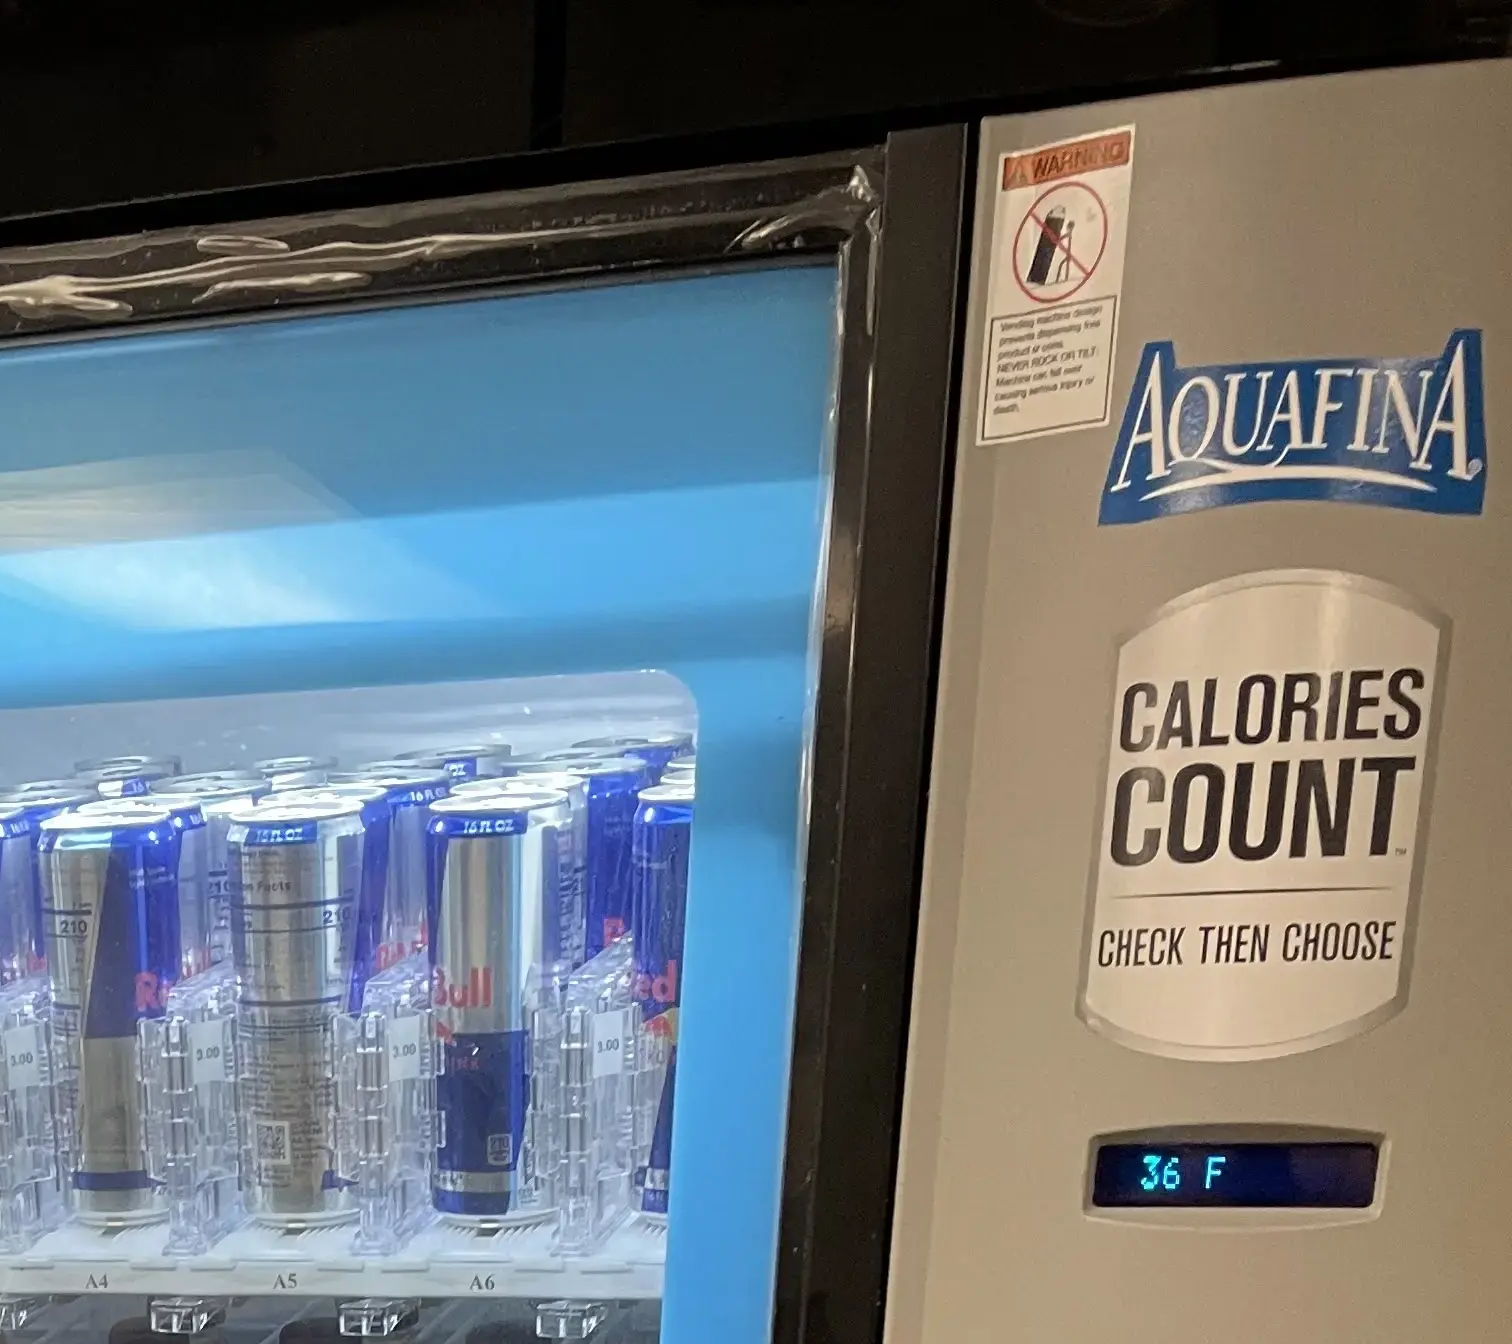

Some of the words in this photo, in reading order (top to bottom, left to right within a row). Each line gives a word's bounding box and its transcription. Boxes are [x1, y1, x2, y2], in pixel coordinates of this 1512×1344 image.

[1032, 141, 1124, 178] WARNING
[997, 360, 1029, 373] NEVER
[1031, 353, 1057, 368] ROCK
[1110, 339, 1478, 492] AQUAFINA
[1119, 668, 1424, 752] CALORIES
[1109, 756, 1416, 867] COUNT
[464, 820, 477, 833] 16
[480, 819, 492, 832] FL
[495, 819, 514, 832] OZ
[60, 920, 87, 934] 210
[1098, 926, 1183, 967] CHECK
[1198, 924, 1270, 964] THEN
[1282, 921, 1396, 963] CHOOSE
[9, 1051, 33, 1068] 3.00
[1140, 1155, 1179, 1191] 36
[1204, 1157, 1226, 1189] F
[85, 1273, 109, 1290] A4
[273, 1273, 297, 1289] A5
[469, 1274, 495, 1292] A6
